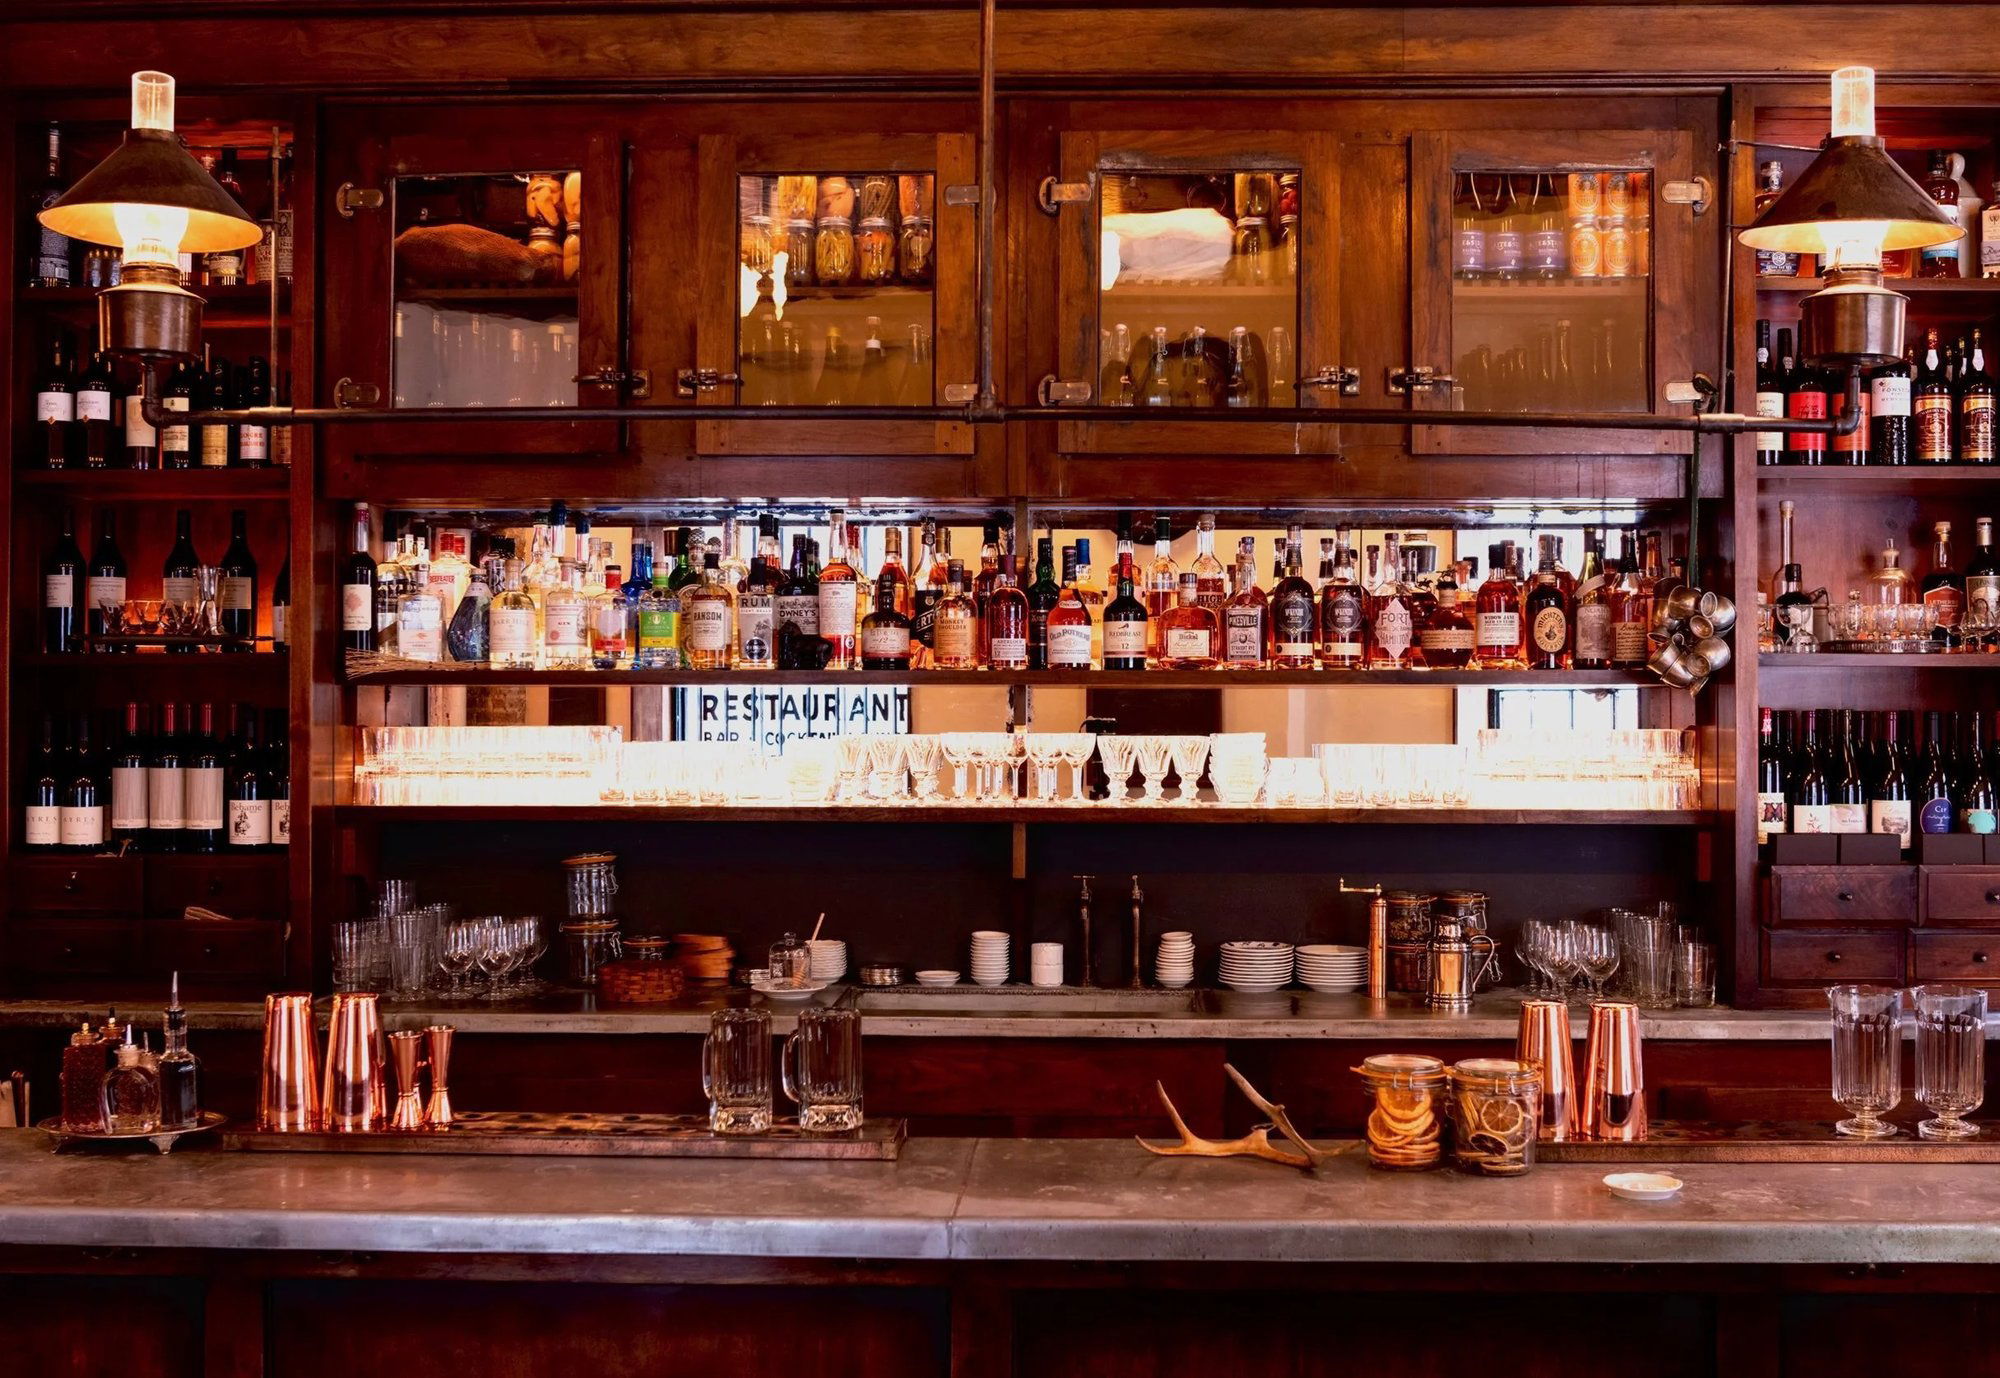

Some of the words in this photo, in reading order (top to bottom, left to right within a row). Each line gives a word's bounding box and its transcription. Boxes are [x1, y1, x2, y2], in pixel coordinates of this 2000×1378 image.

[429, 575, 455, 583] BEEFEATER
[741, 598, 770, 608] RUM
[694, 612, 722, 622] RANSOM
[779, 610, 816, 618] OWNEY'S
[1381, 613, 1409, 625] FORT
[1229, 615, 1258, 626] PIKESVILLE
[1379, 634, 1410, 645] HAMILTON
[702, 693, 908, 722] RESTAURANT
[704, 732, 739, 742] BAR
